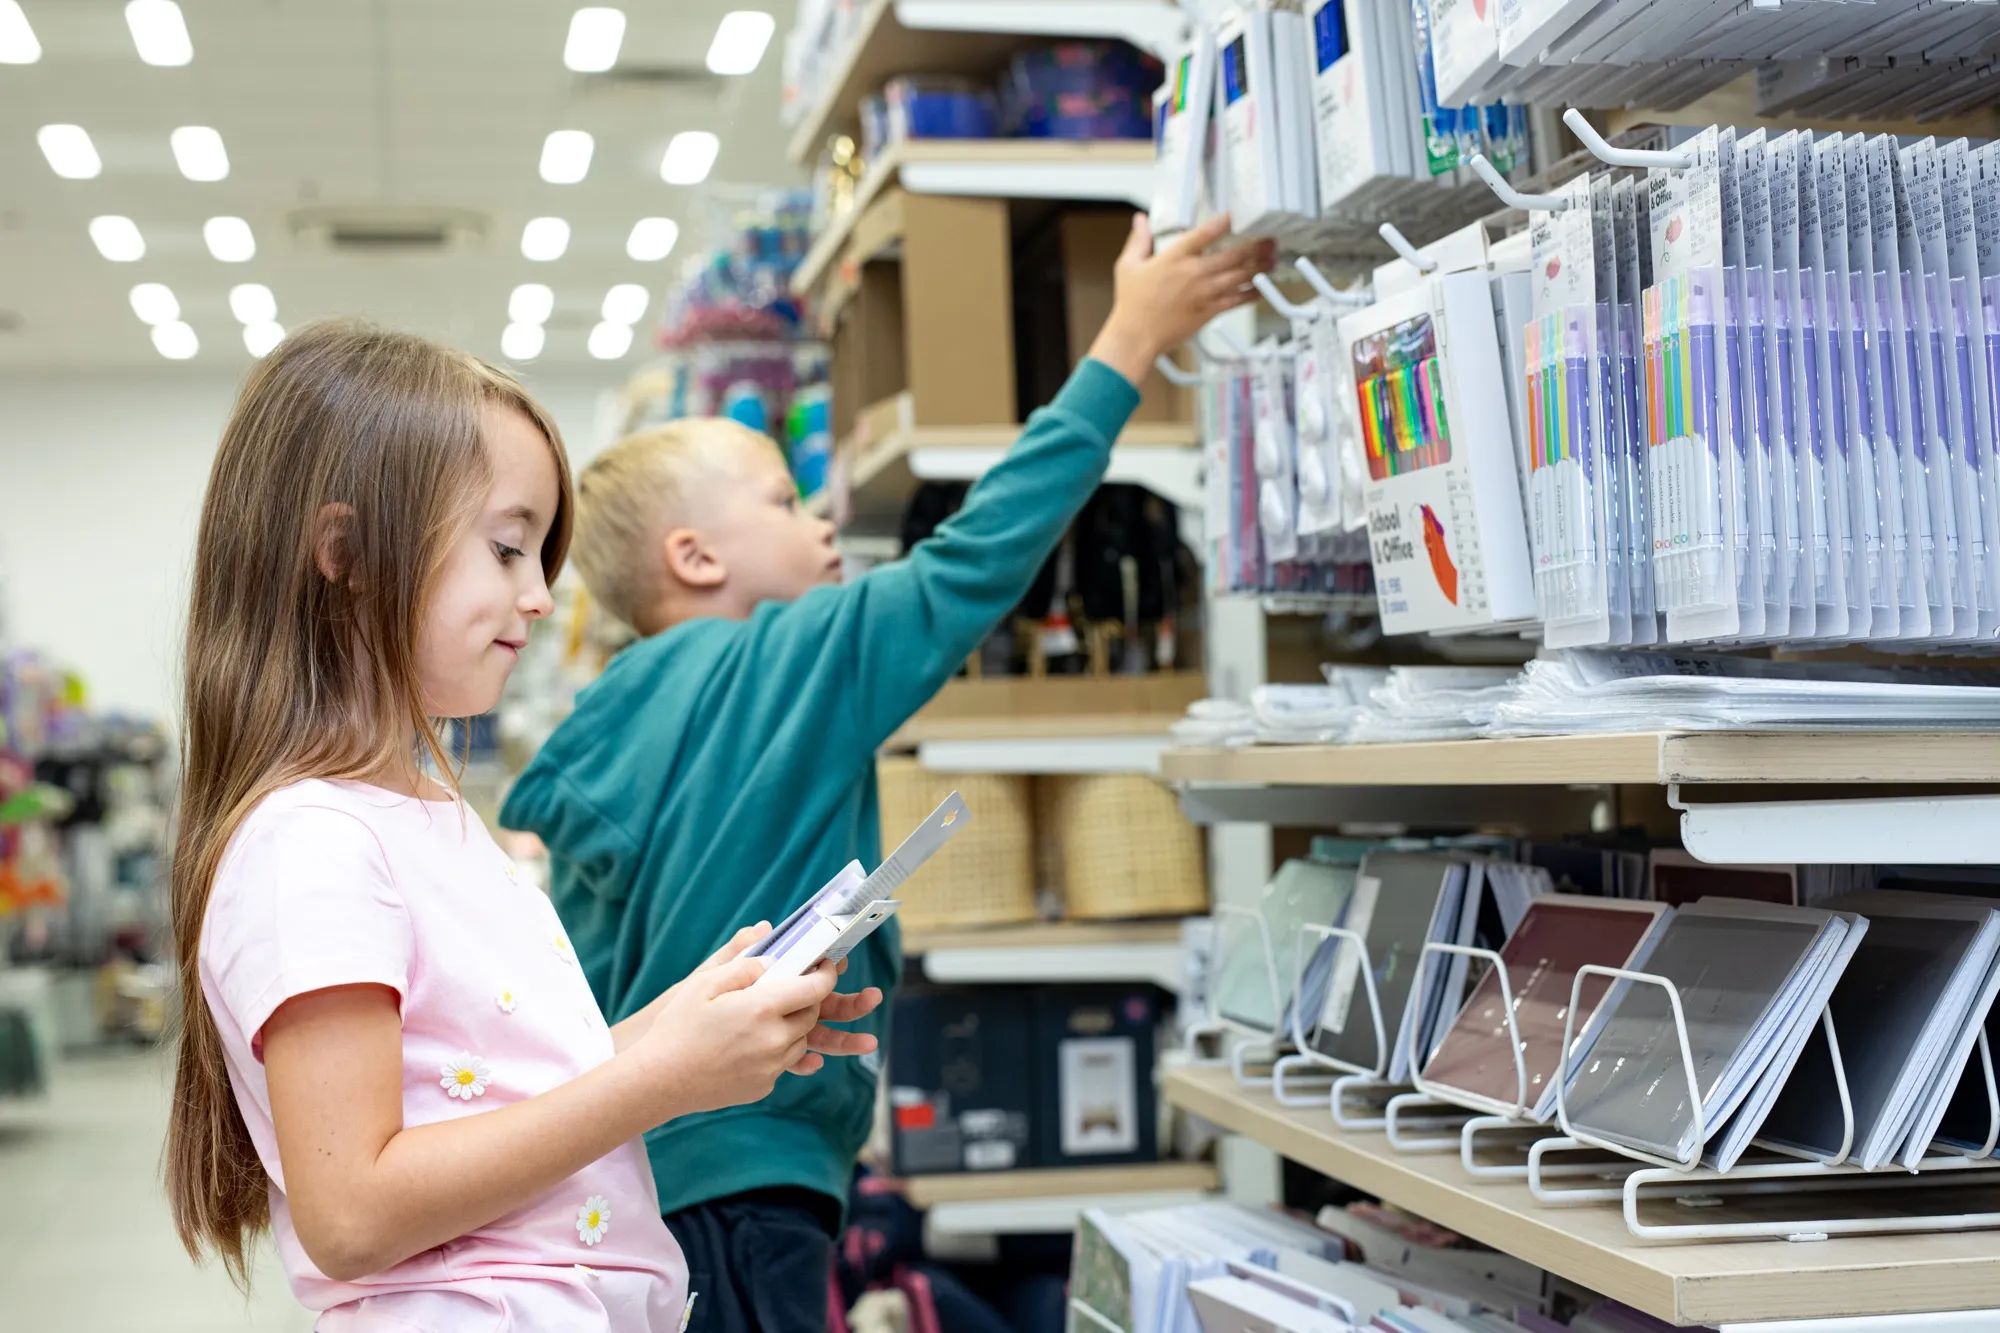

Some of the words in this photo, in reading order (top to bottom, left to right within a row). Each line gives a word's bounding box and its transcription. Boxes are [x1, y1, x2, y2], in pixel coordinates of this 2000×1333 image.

[1649, 172, 1667, 195] School
[1920, 176, 1929, 184] RON
[1949, 177, 1958, 186] RON
[1958, 172, 1967, 183] 7,50
[1987, 178, 1996, 187] RON
[1650, 197, 1656, 210] &
[1655, 189, 1673, 207] Office
[1922, 192, 1930, 201] CZK
[1932, 187, 1939, 196] 40
[1951, 194, 1959, 203] CZK
[1962, 189, 1969, 198] 40
[1988, 194, 1997, 203] CZK
[1924, 208, 1932, 217] RSD
[1932, 204, 1941, 215] 200
[1953, 210, 1961, 220] RSD
[1961, 206, 1970, 217] 200
[1980, 214, 1990, 224] 3,50
[1990, 211, 1999, 220] RSD
[1934, 221, 1943, 232] 600
[1954, 227, 1963, 237] HUF
[1963, 223, 1972, 234] 600
[1981, 230, 1990, 241] 3,50
[1369, 502, 1401, 534] School
[1382, 535, 1414, 564] Office
